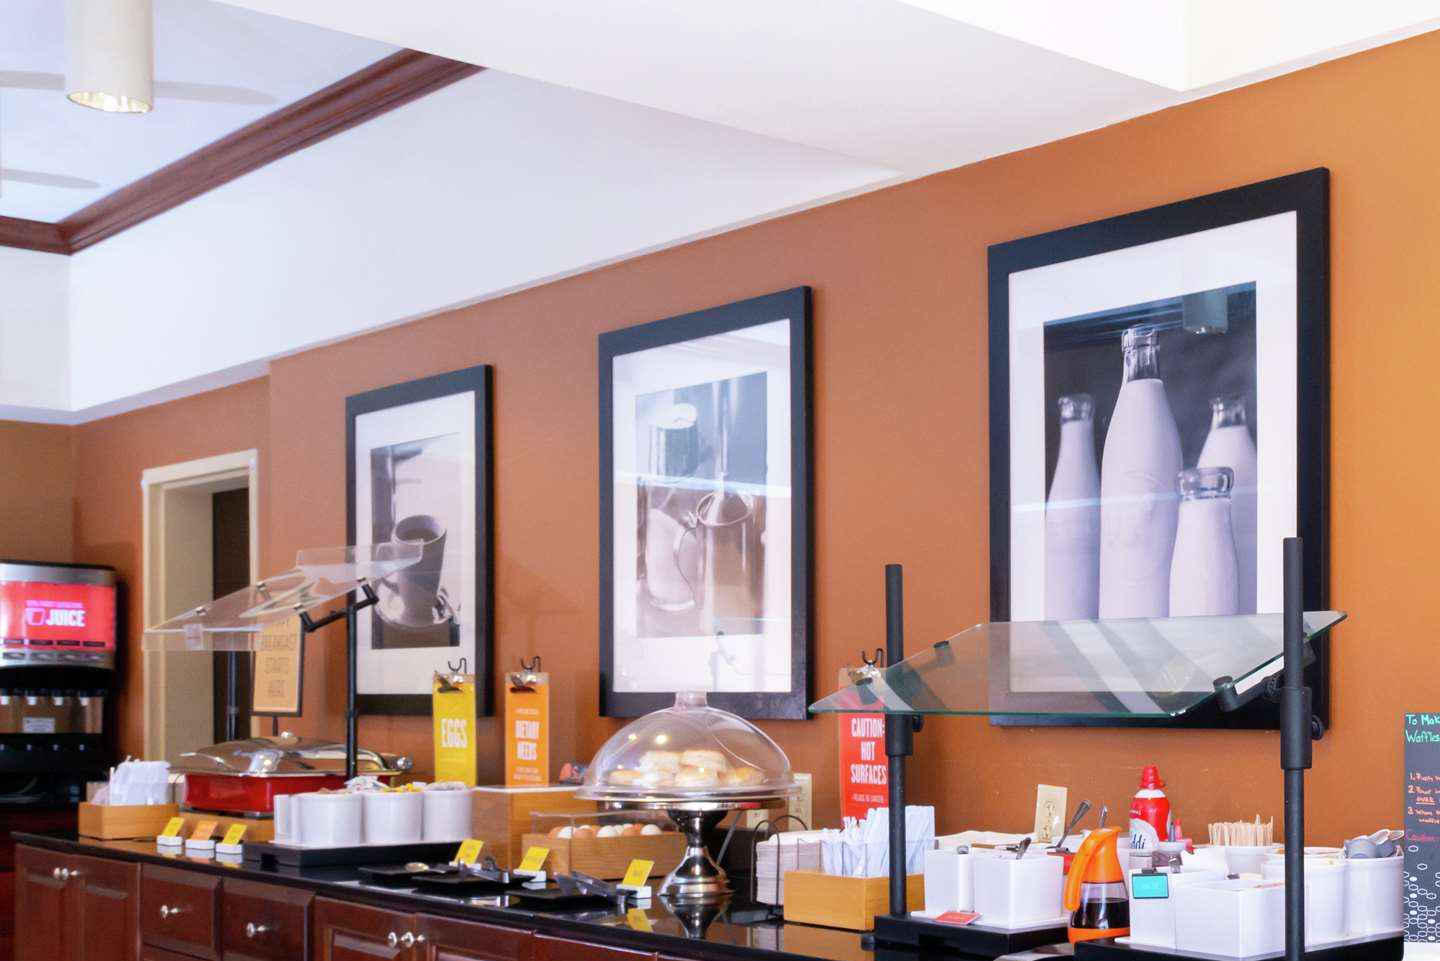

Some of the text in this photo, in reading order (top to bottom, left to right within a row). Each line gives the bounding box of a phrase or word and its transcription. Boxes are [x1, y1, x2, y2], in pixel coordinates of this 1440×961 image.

[45, 608, 86, 627] JUICE
[851, 717, 886, 738] CAUTION:
[1405, 714, 1418, 725] To
[441, 718, 468, 749] EGGS
[1405, 729, 1440, 743] Waffles
[860, 741, 875, 761] HOT
[850, 763, 887, 785] SURFACES
